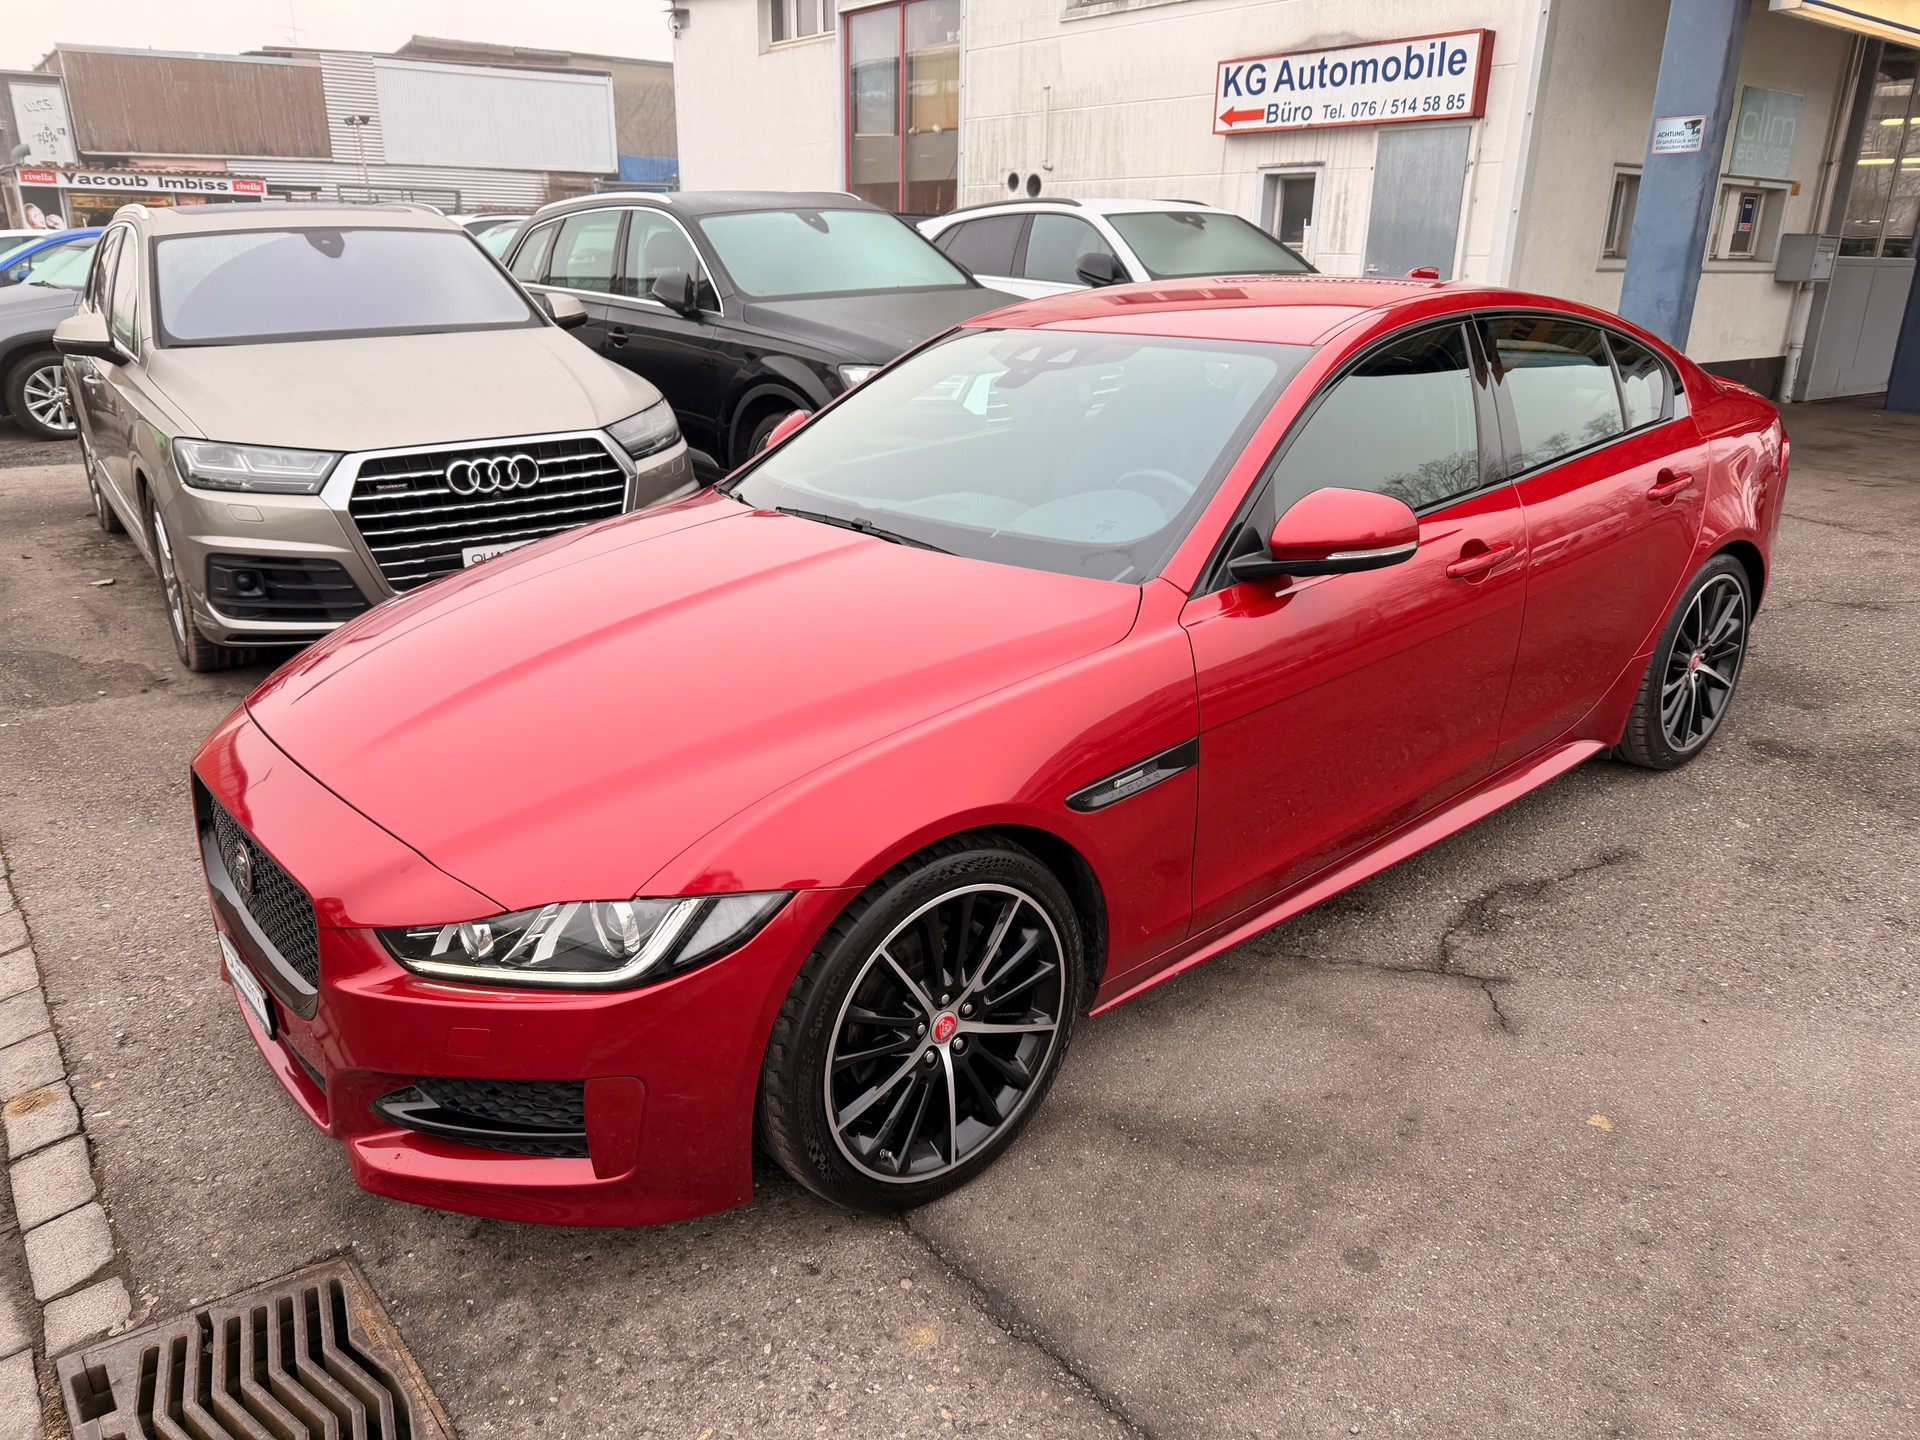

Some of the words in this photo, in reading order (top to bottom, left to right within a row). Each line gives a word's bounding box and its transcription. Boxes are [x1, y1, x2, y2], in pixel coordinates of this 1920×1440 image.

[1223, 63, 1267, 98] KG
[1273, 41, 1468, 93] Automobile
[1265, 102, 1313, 124] Büro
[1322, 104, 1346, 119] Tel.
[1350, 101, 1376, 117] 076
[1380, 99, 1387, 116] /
[1391, 97, 1417, 115] 514
[1422, 95, 1440, 112] 58
[1446, 93, 1465, 110] 85
[1657, 130, 1685, 138] ACHTUNG
[1736, 143, 1791, 165] service
[23, 171, 54, 183] rivella
[62, 172, 149, 188] Yacoub
[157, 176, 229, 192] Imbiss
[235, 181, 262, 192] rivella
[1108, 772, 1161, 800] JAGUAR
